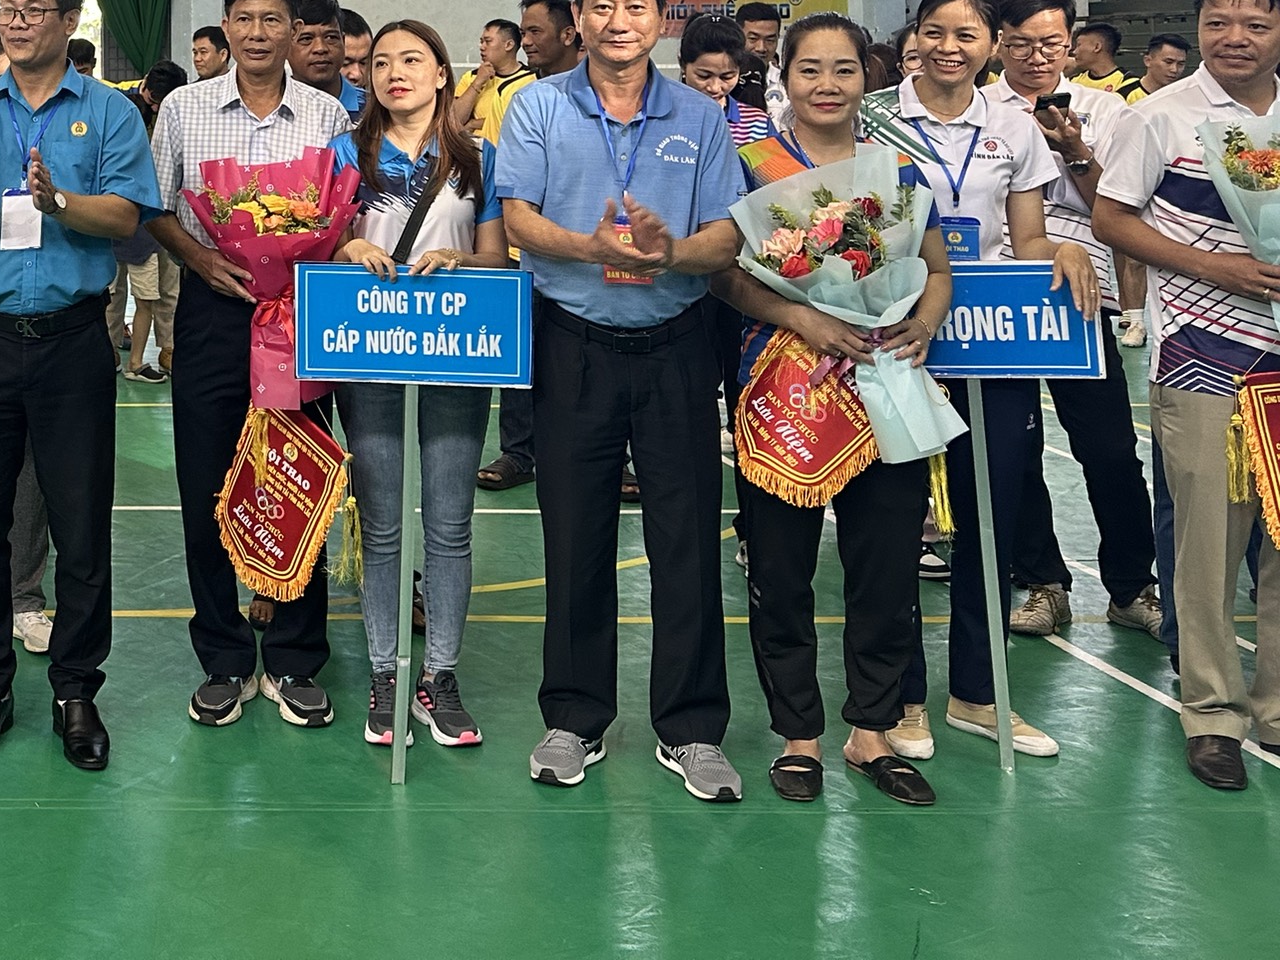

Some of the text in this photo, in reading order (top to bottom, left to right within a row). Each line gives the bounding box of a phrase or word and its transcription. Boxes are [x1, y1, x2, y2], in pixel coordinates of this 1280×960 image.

[357, 285, 466, 316] CÔNG TY CP
[323, 321, 502, 358] CẤP NƯỚC ĐẮK LẮK
[935, 298, 1070, 350] RỌNG TÀI
[766, 390, 783, 408] BAN
[752, 397, 813, 463] Lưu Niệm
[267, 448, 281, 466] ỘI
[281, 461, 310, 490] THAO
[242, 498, 256, 514] BAN
[233, 505, 284, 560] Lưu Niệm
